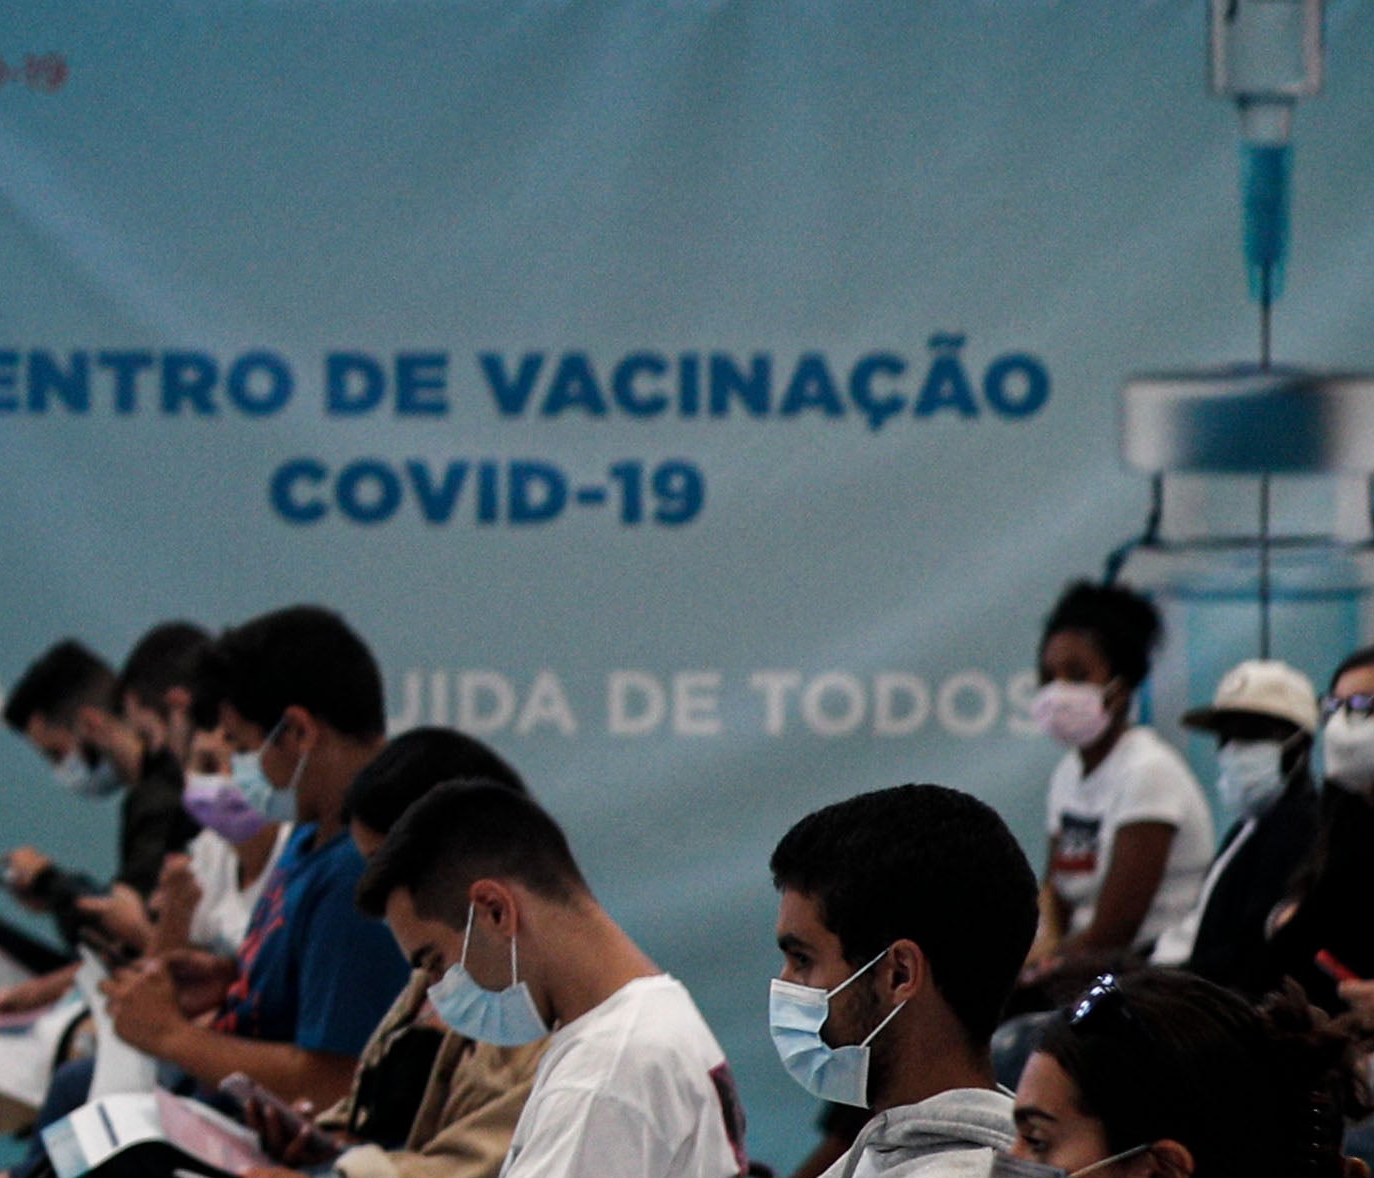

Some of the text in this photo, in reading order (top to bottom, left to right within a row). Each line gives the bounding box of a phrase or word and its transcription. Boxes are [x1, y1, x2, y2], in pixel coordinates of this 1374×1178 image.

[324, 351, 450, 416] DE
[477, 332, 1052, 432] VACINAÇÃO
[269, 457, 707, 526] COVID-19
[385, 669, 577, 737] UIDA
[606, 669, 723, 737] DE
[748, 669, 1043, 738] TODOS
